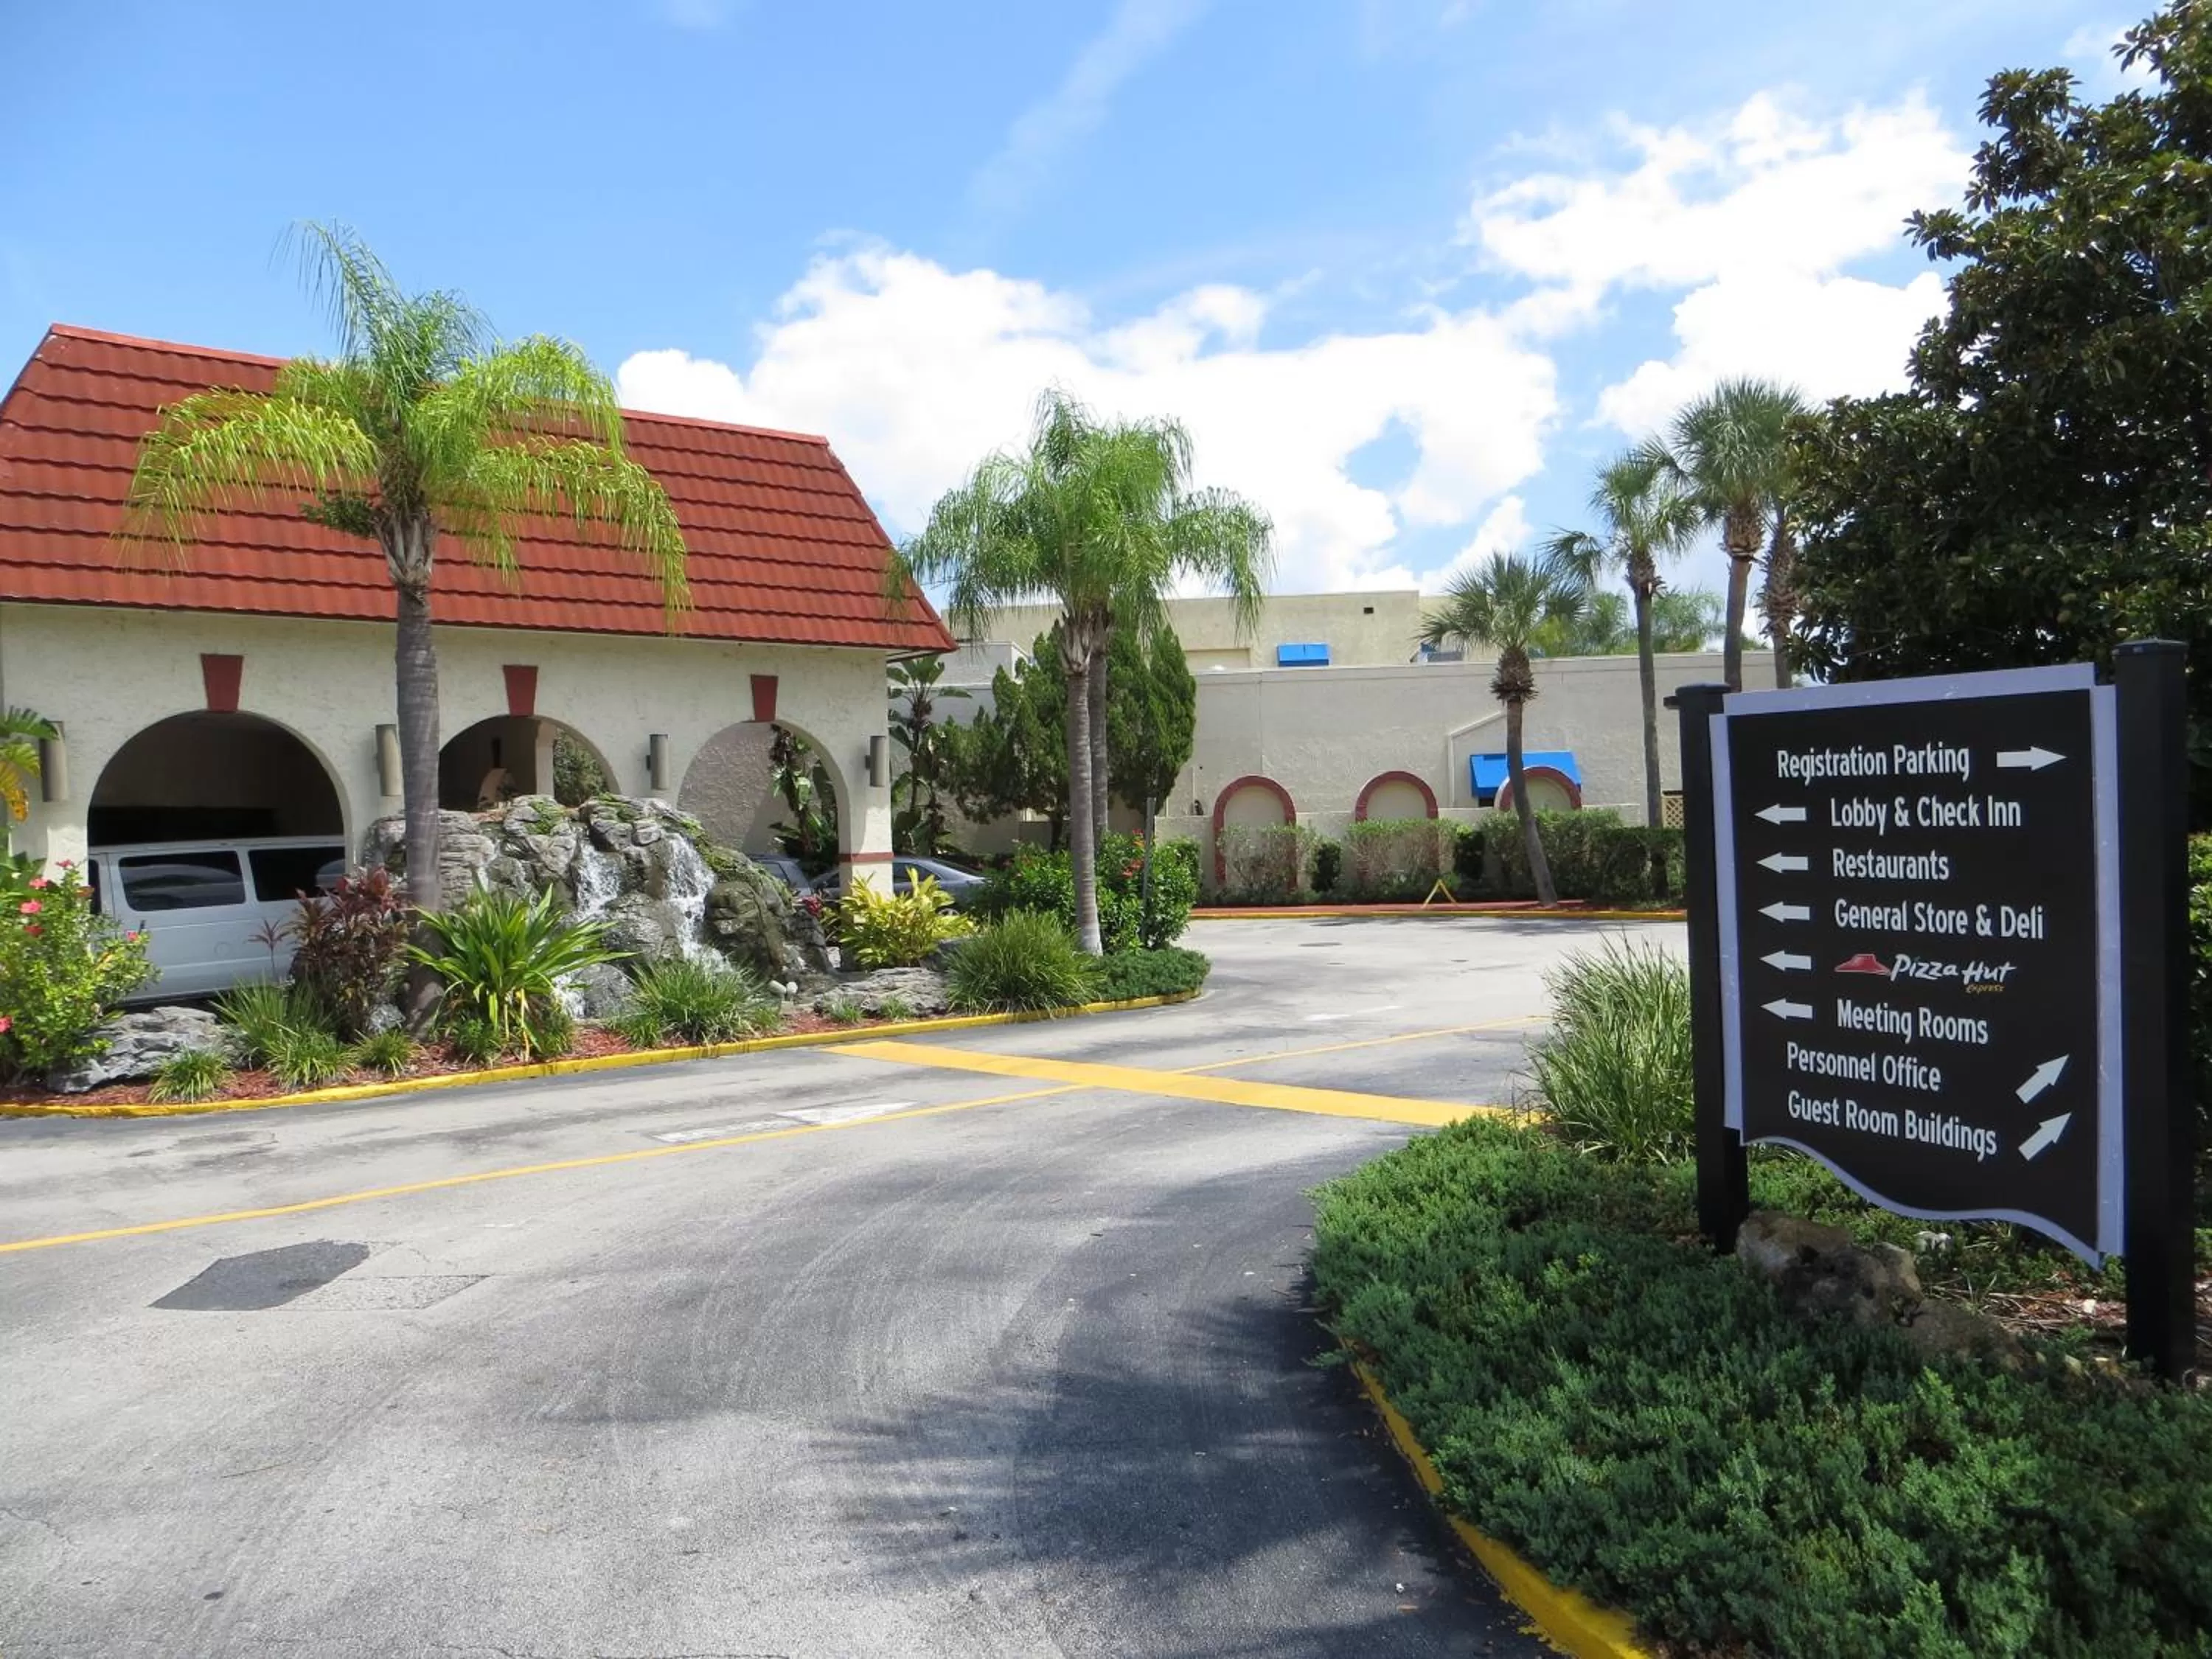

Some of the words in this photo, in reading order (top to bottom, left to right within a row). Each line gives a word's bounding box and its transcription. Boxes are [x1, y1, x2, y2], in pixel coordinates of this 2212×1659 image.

[1777, 746, 1888, 785] Registration
[1893, 742, 1969, 782] Parking
[1831, 798, 1887, 835] Lobby
[1894, 796, 1910, 827] &
[1916, 795, 1981, 827] Check
[1987, 795, 2021, 827] Inn
[1832, 848, 1950, 880] Restaurants
[1834, 899, 1908, 931] General
[1914, 902, 1968, 934] Store
[1975, 904, 1993, 936] &
[2000, 905, 2043, 939] Deli
[1890, 953, 1960, 981] Pizza
[1961, 960, 2017, 985] Hut
[1837, 998, 1913, 1044] Meeting
[1919, 1006, 1989, 1046] Rooms
[1787, 1041, 1877, 1082] Personnel
[1882, 1055, 1942, 1091] Office
[1788, 1091, 1840, 1127] Guest
[1846, 1099, 1899, 1137] Room
[1905, 1109, 1997, 1162] Buildings
